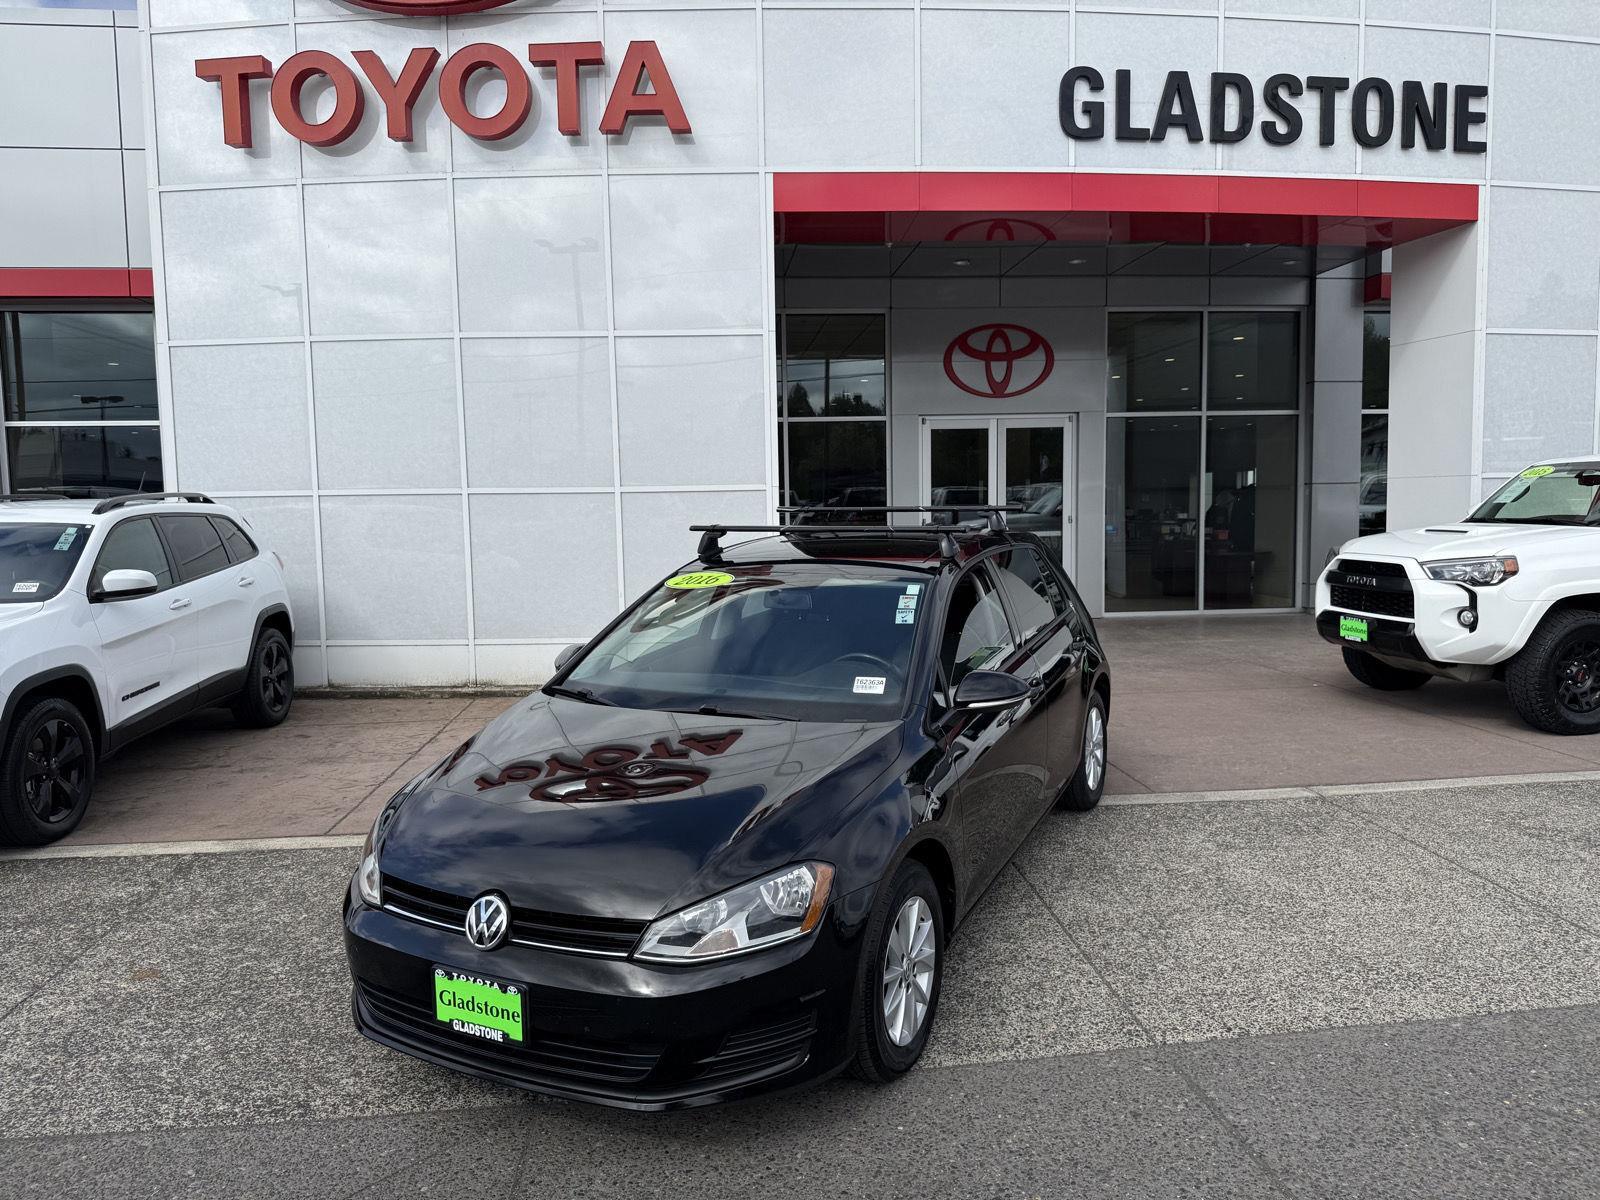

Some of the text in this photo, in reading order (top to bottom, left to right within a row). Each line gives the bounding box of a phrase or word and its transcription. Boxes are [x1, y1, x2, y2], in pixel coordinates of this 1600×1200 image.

[195, 40, 693, 149] TOYOTA
[1059, 66, 1489, 153] GLADSTONE
[673, 574, 725, 586] 2016
[1346, 575, 1376, 586] TOYOTA
[452, 972, 500, 990] TOYOTA
[439, 990, 521, 1024] Gladstone
[452, 1019, 504, 1042] GLADSTONE
